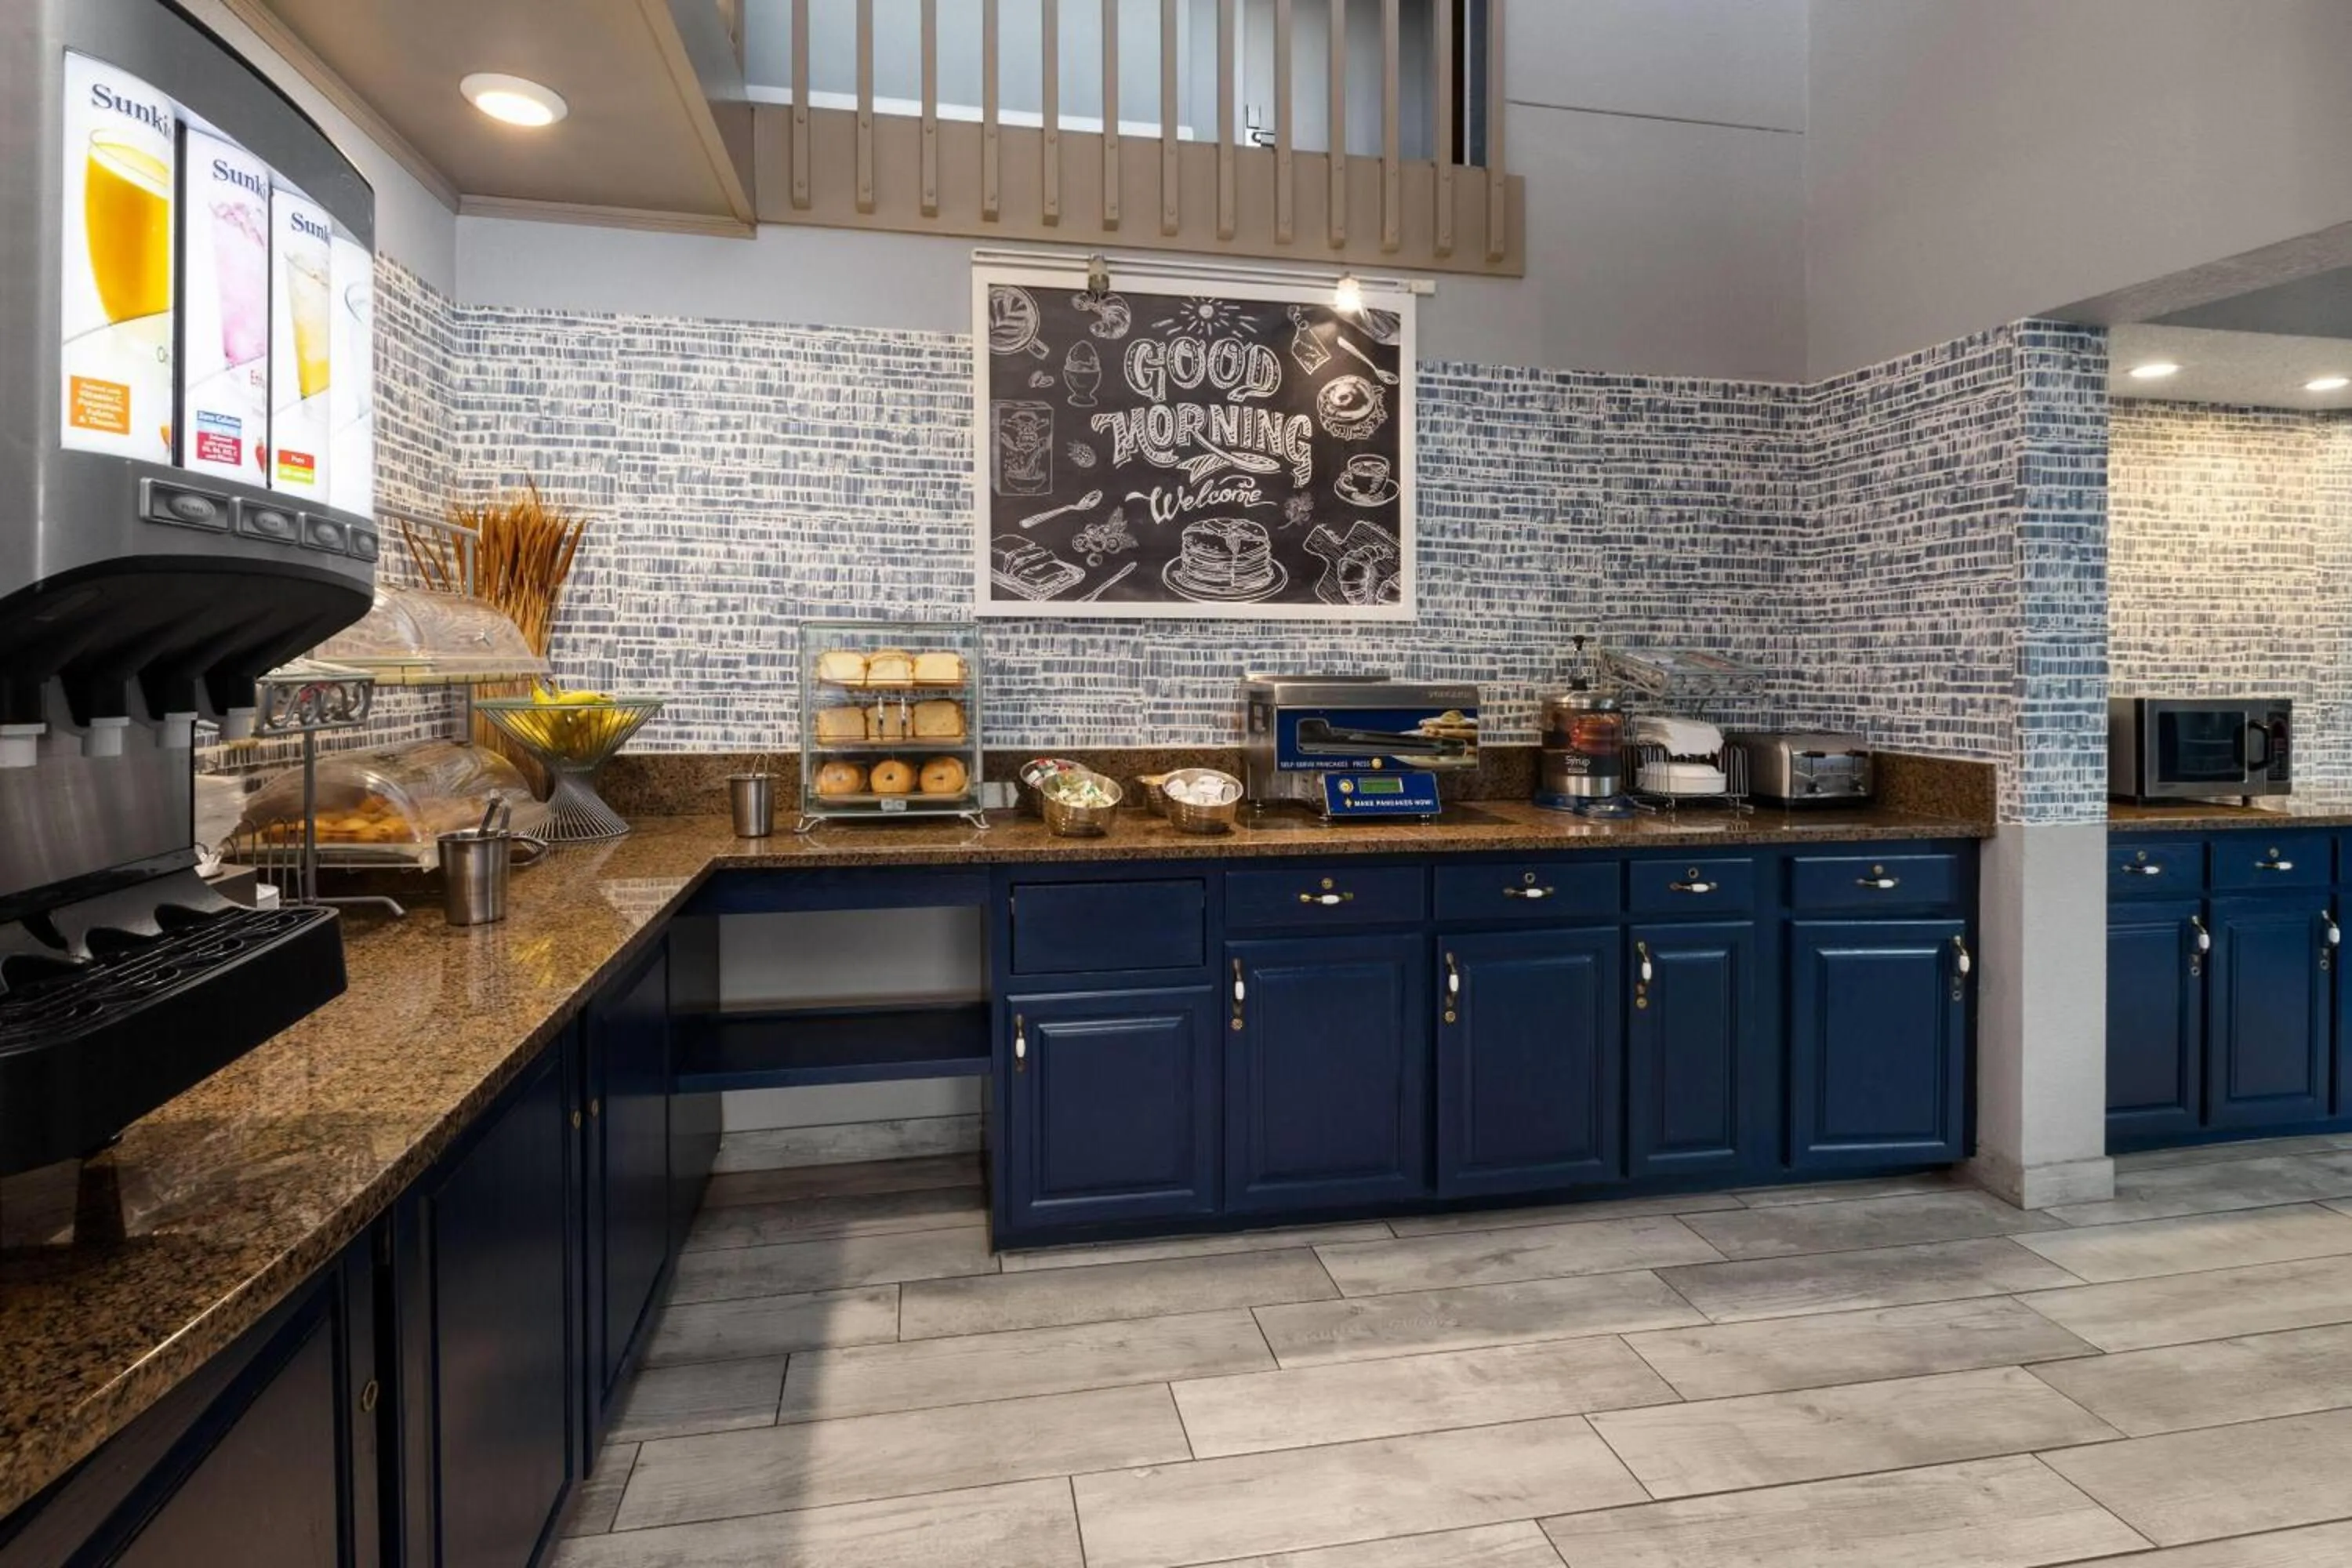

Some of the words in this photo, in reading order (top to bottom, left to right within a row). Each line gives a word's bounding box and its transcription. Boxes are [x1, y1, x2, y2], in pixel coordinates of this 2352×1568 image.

[1124, 336, 1282, 402] GOOD
[1092, 402, 1313, 489] MORNING
[1124, 475, 1277, 524] Welcome
[1564, 755, 1591, 767] Syrup
